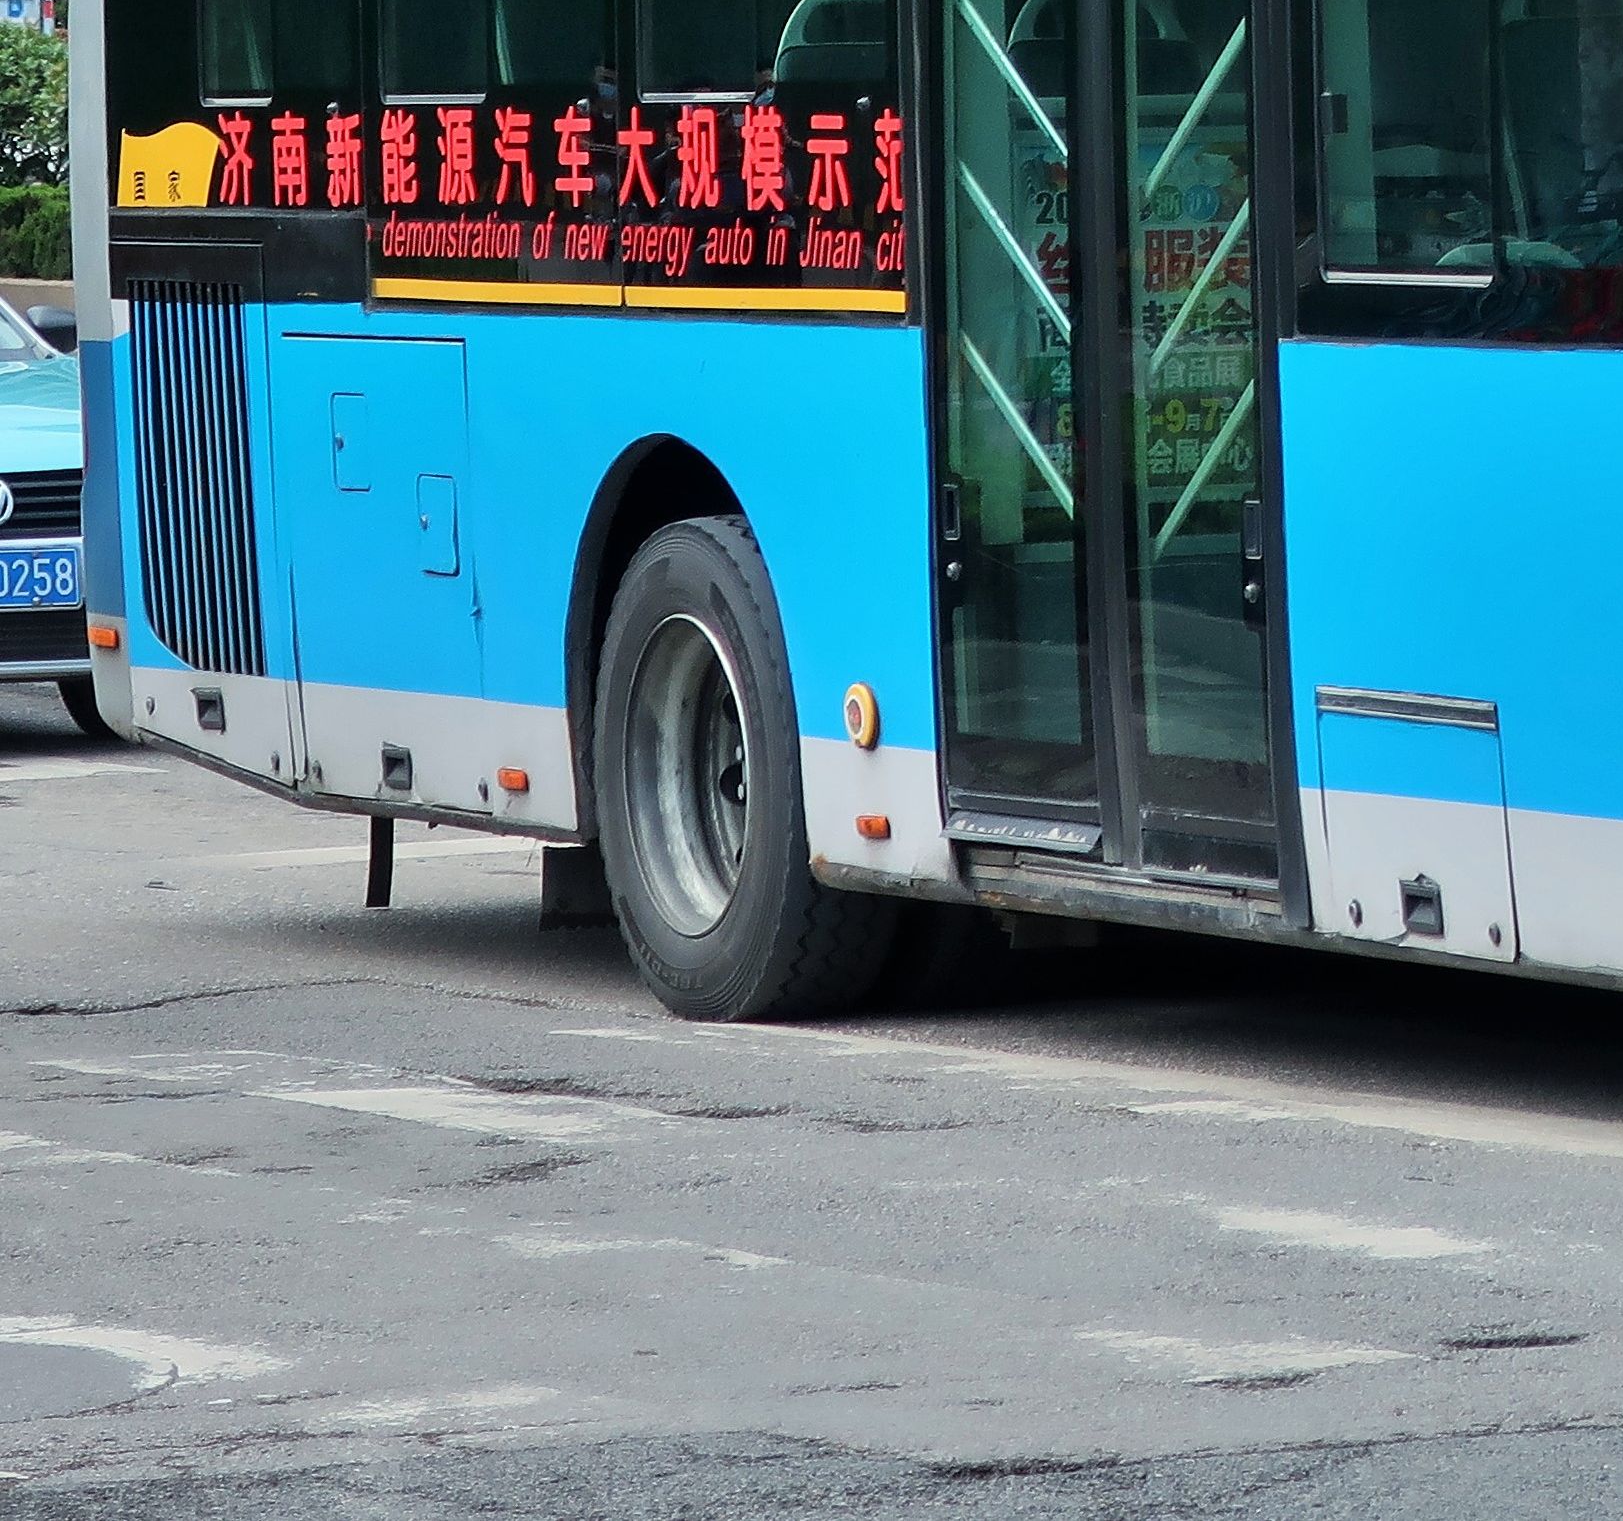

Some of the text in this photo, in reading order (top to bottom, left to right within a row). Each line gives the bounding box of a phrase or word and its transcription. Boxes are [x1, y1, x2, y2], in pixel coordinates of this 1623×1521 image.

[217, 105, 905, 214] 济南新能源汽车大规模示范
[382, 209, 522, 259] demonstration
[532, 210, 558, 260] of
[564, 223, 610, 260] new
[621, 223, 694, 277] energy
[704, 217, 753, 266] auto
[766, 216, 787, 266] in
[799, 216, 863, 270] Jinan
